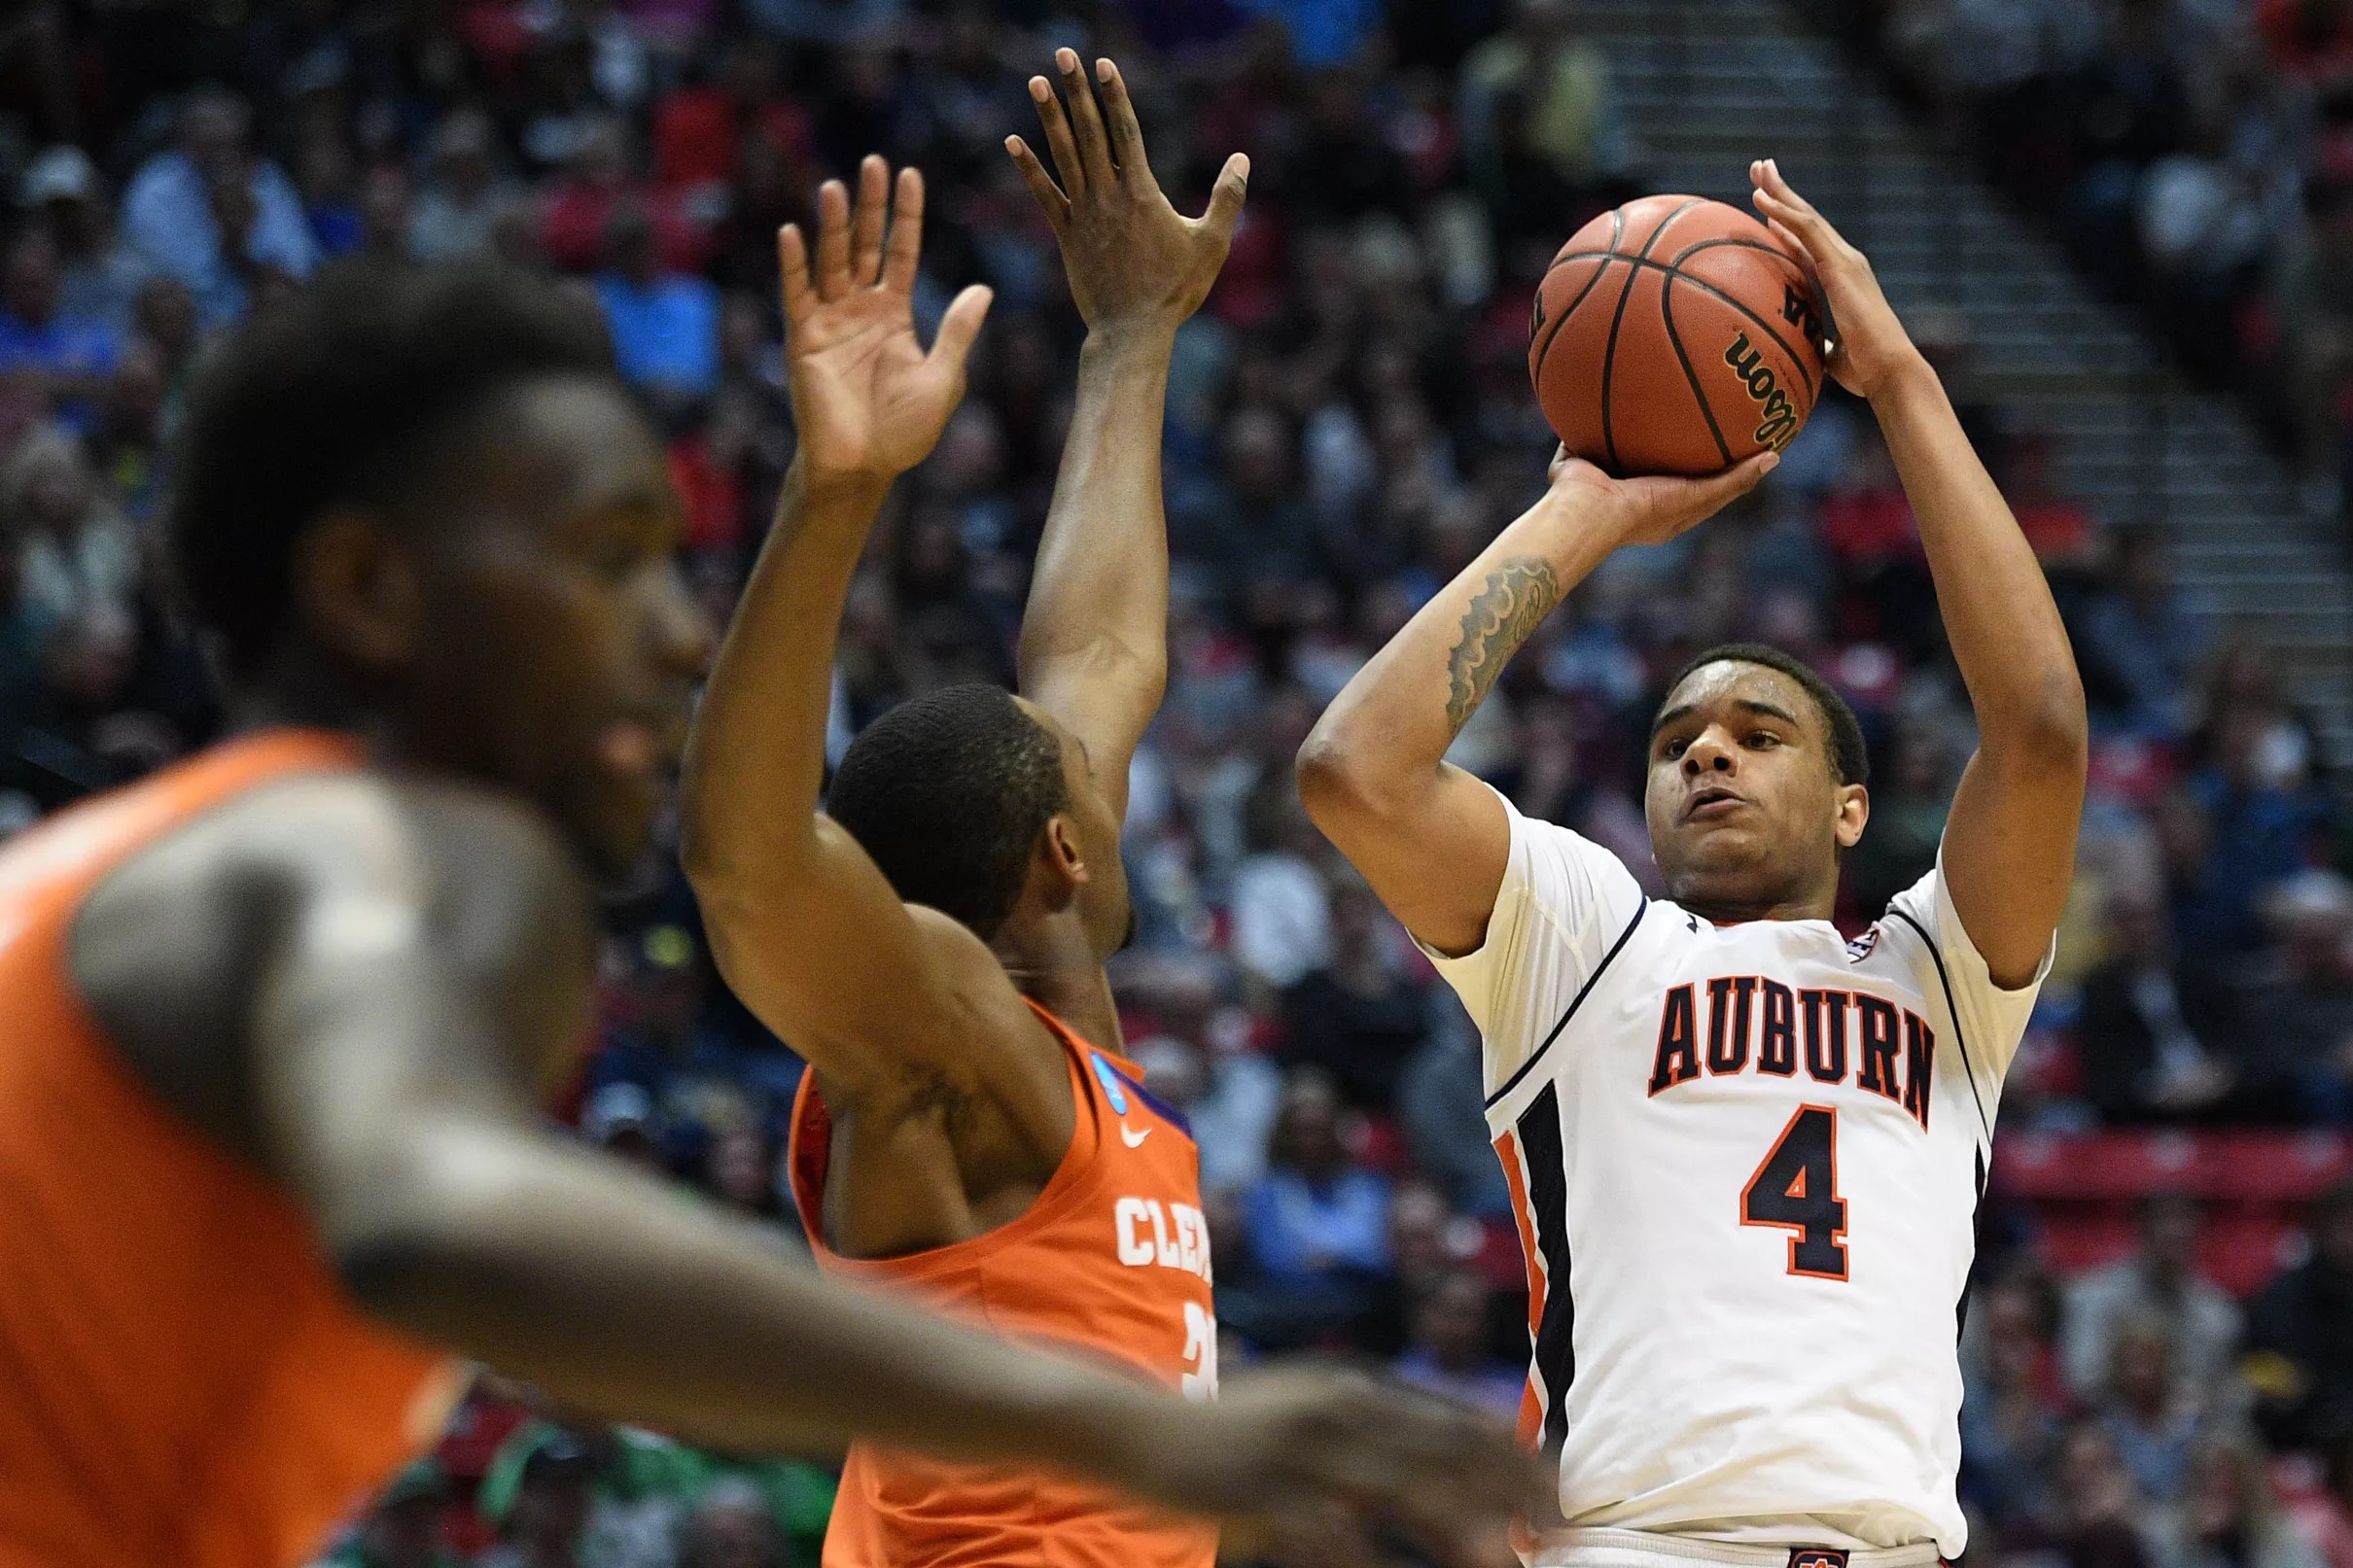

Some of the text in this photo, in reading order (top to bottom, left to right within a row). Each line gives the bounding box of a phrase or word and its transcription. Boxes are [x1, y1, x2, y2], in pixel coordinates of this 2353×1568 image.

[1724, 330, 1799, 452] ilson
[1647, 975, 1936, 1135] AUBURN
[1739, 1102, 1849, 1283] 4
[1181, 1300, 1218, 1405] 2
